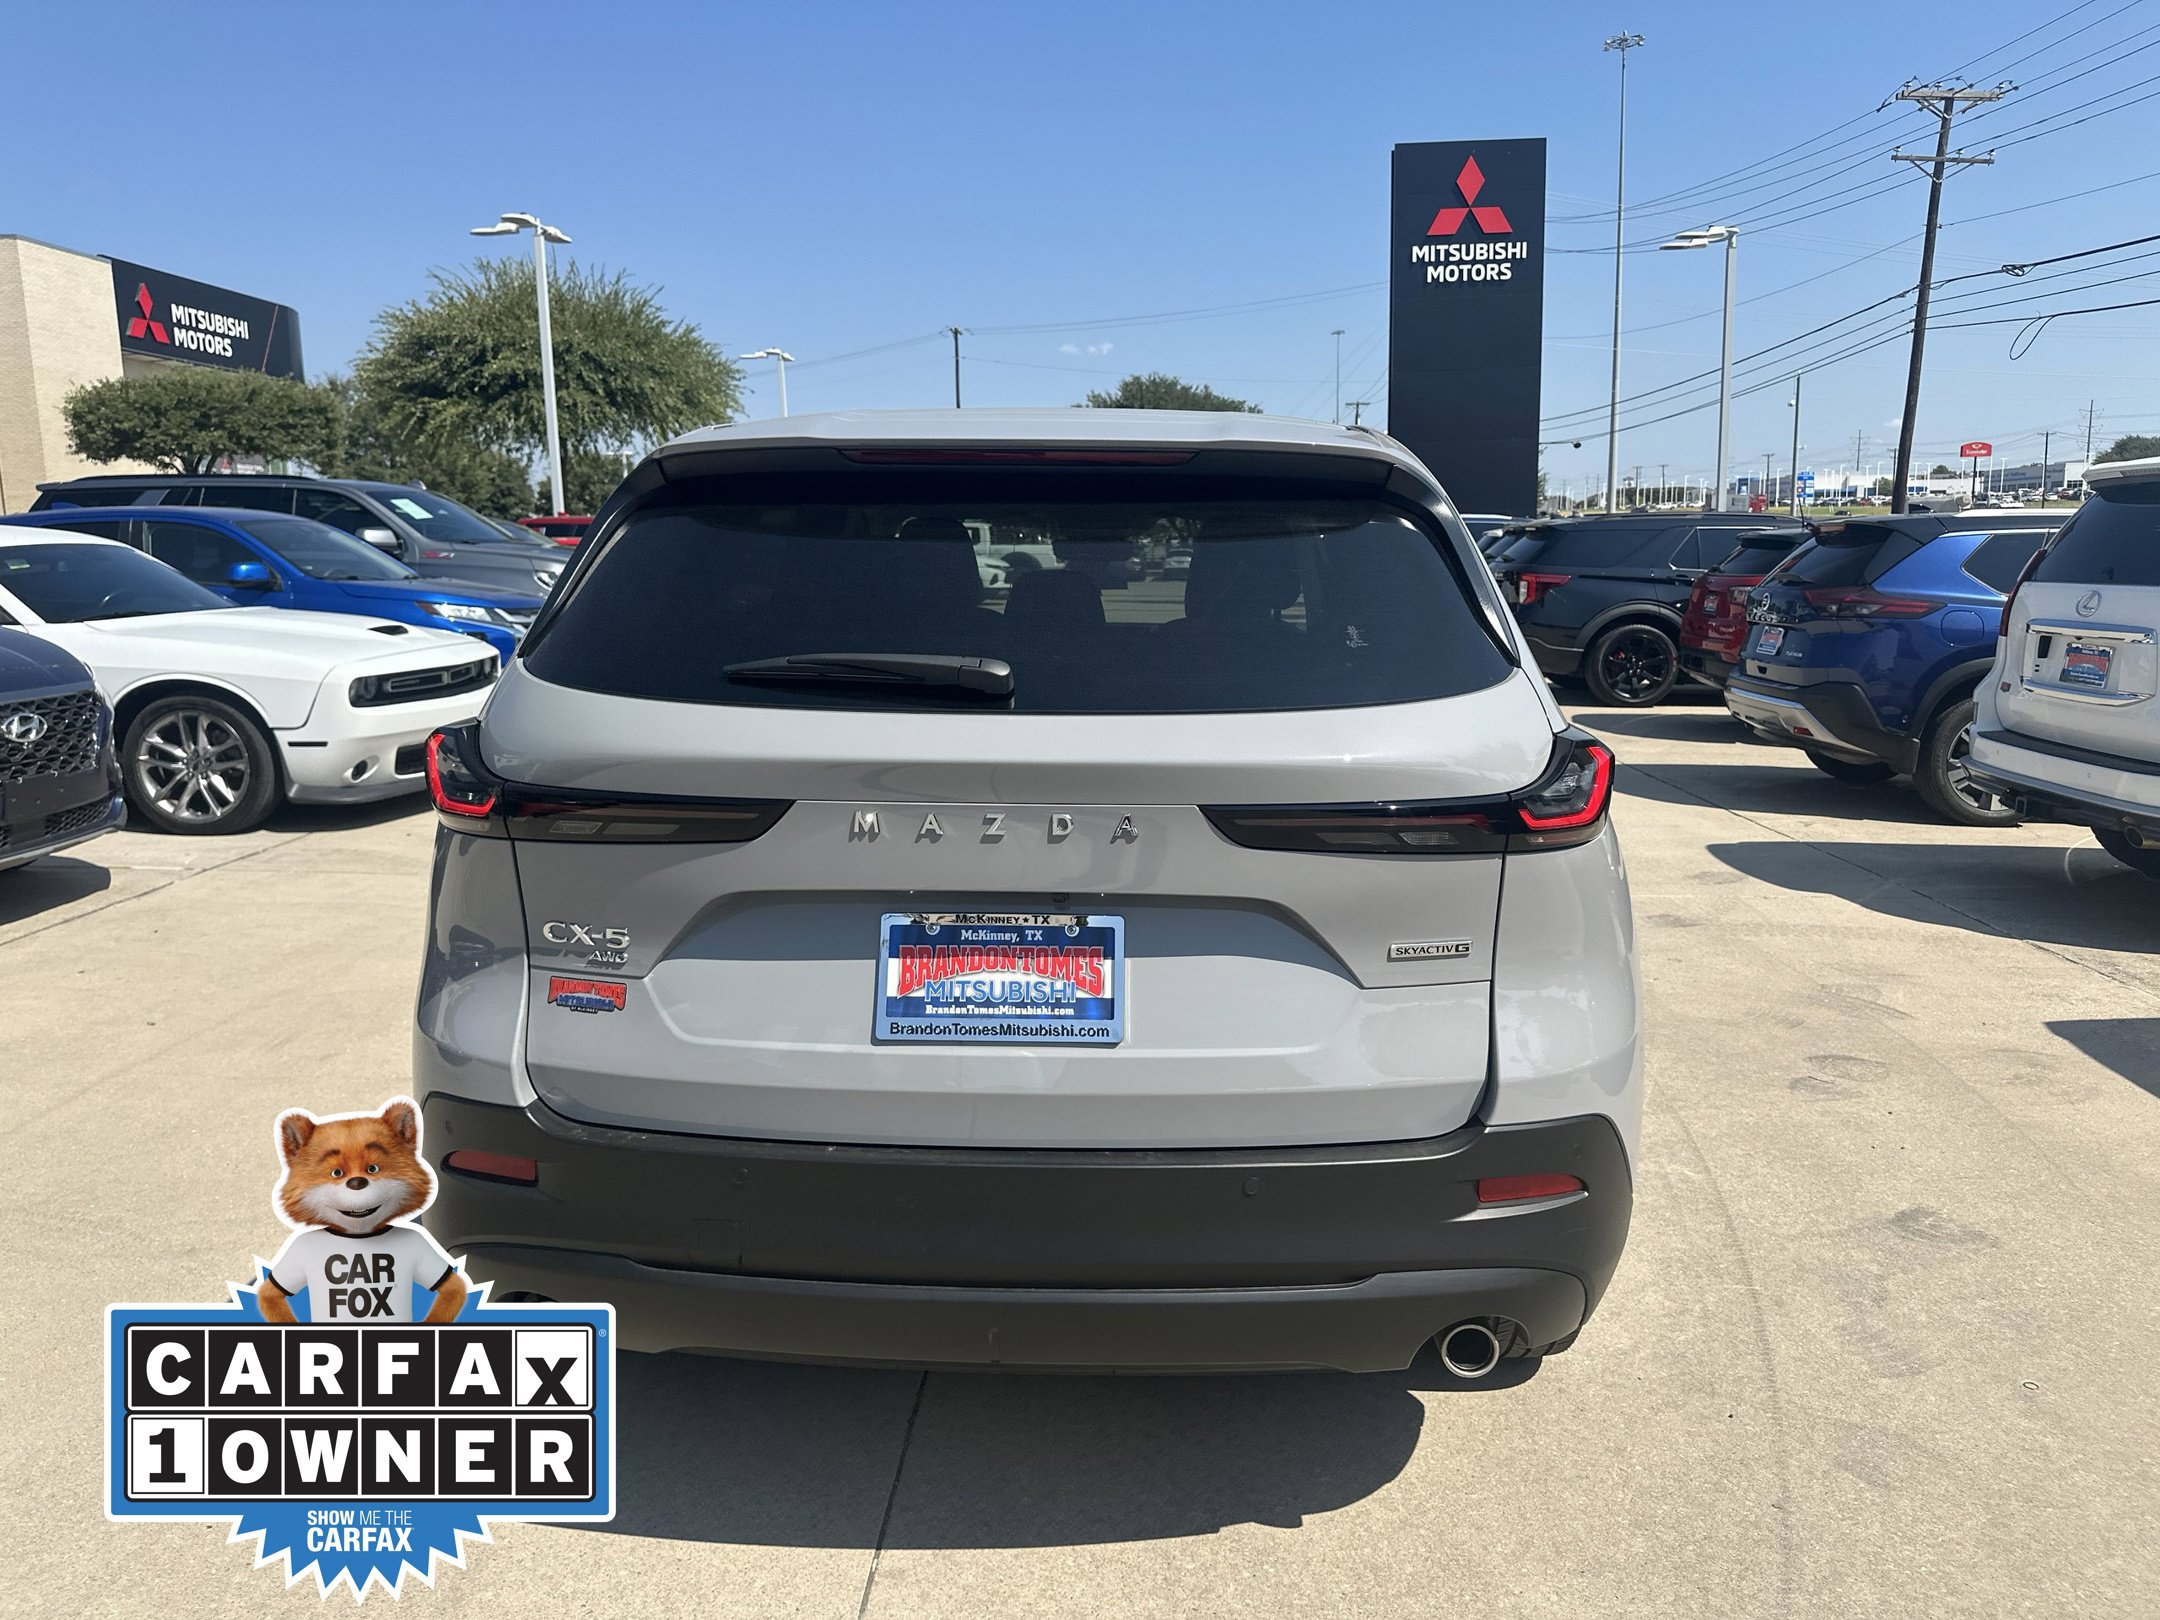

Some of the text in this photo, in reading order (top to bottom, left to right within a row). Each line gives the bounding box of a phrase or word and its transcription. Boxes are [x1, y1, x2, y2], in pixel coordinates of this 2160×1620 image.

[1411, 242, 1527, 263] MITSUBISHI
[1426, 263, 1512, 283] MOTORS
[170, 303, 249, 340] MITSUBISHI
[173, 327, 233, 358] MOTORS
[852, 810, 1139, 837] MAZDA
[1031, 915, 1050, 925] TX
[542, 922, 631, 949] CX-5
[1025, 930, 1043, 941] TX
[588, 950, 629, 963] AWD
[924, 980, 1077, 1003] MITSUBISHI
[925, 1004, 1075, 1016] BrandonTomesMitsubishi.com
[889, 1022, 1110, 1038] BrandonTomesMitsubishi.com
